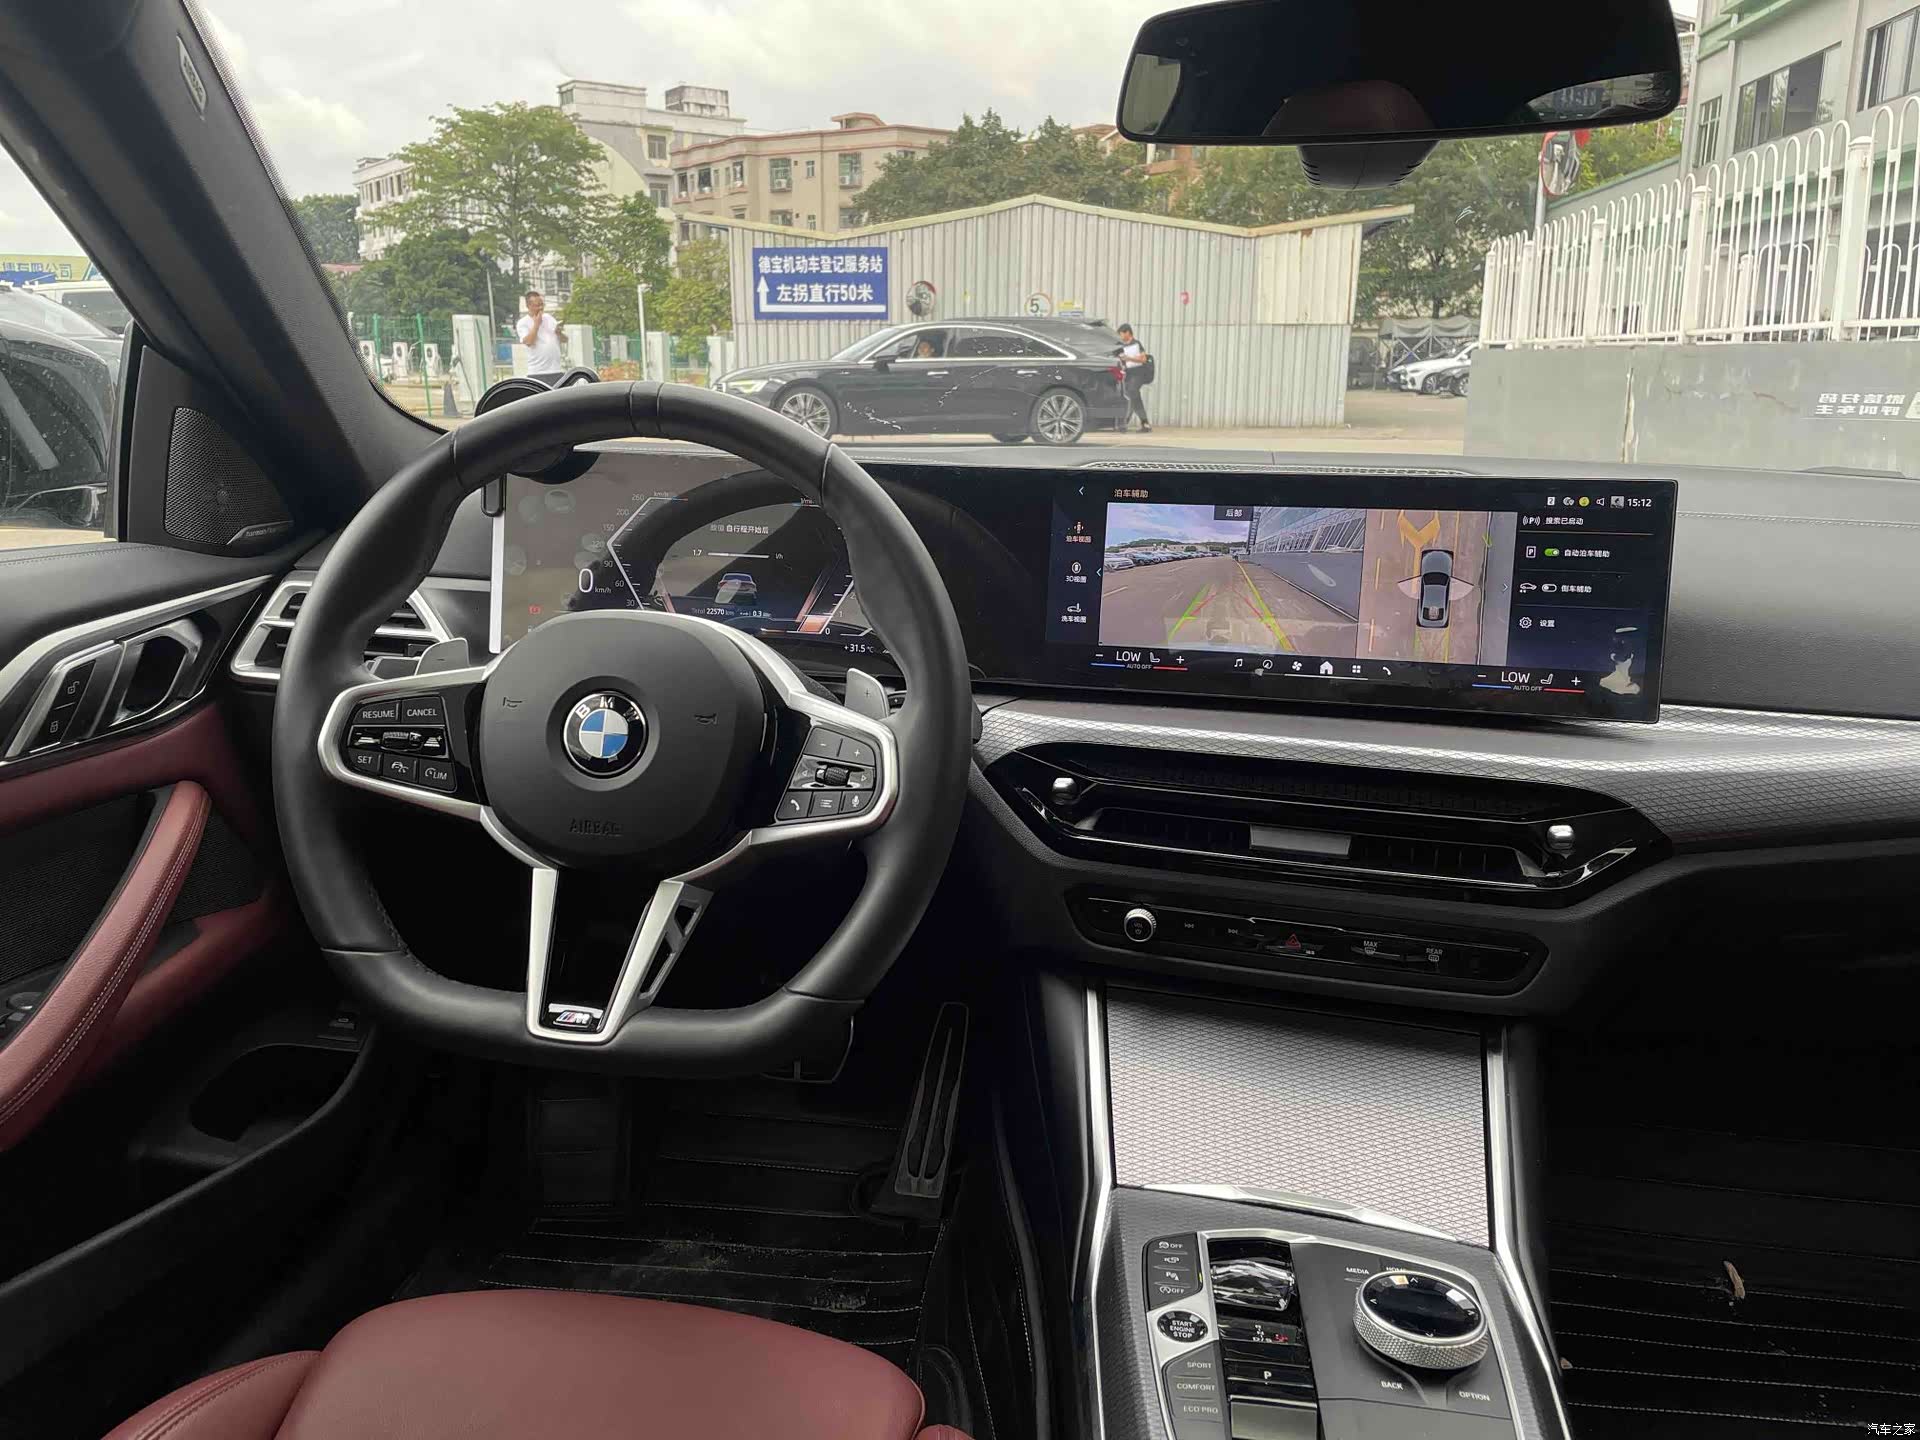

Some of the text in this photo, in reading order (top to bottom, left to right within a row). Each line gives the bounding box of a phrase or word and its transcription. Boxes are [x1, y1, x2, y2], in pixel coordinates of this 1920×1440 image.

[758, 255, 883, 273] 德宝机动车登记服务站
[776, 283, 874, 303] 左拐直行50米
[1030, 298, 1039, 313] 5
[1113, 488, 1149, 499] 泊车辅助
[1627, 498, 1652, 508] 15:12
[1225, 508, 1243, 517] 后部
[1564, 549, 1611, 558] 自动泊车辅助
[603, 560, 613, 568] 90
[578, 568, 594, 593] 0
[594, 586, 612, 594] km/h
[1561, 584, 1593, 594] 倒车辅助
[706, 607, 725, 616] 22570
[1540, 619, 1555, 628] 设置
[824, 628, 831, 636] 0
[1115, 650, 1142, 662] LOW
[1501, 671, 1530, 683] LOW
[406, 708, 438, 717] CANCEL
[575, 696, 640, 722] BMW
[362, 709, 395, 719] RESUME
[357, 755, 372, 764] SET
[433, 771, 448, 780] LIM
[1363, 940, 1378, 948] MAX
[1346, 1266, 1370, 1274] MEDIA
[1170, 1325, 1195, 1334] ENGINE
[1187, 1361, 1212, 1369] SPORT
[1263, 1370, 1272, 1379] P
[1176, 1383, 1216, 1391] COMFORT
[1380, 1380, 1404, 1390] BACK
[1458, 1390, 1491, 1401] OPTION
[1183, 1405, 1219, 1414] ECO PRO
